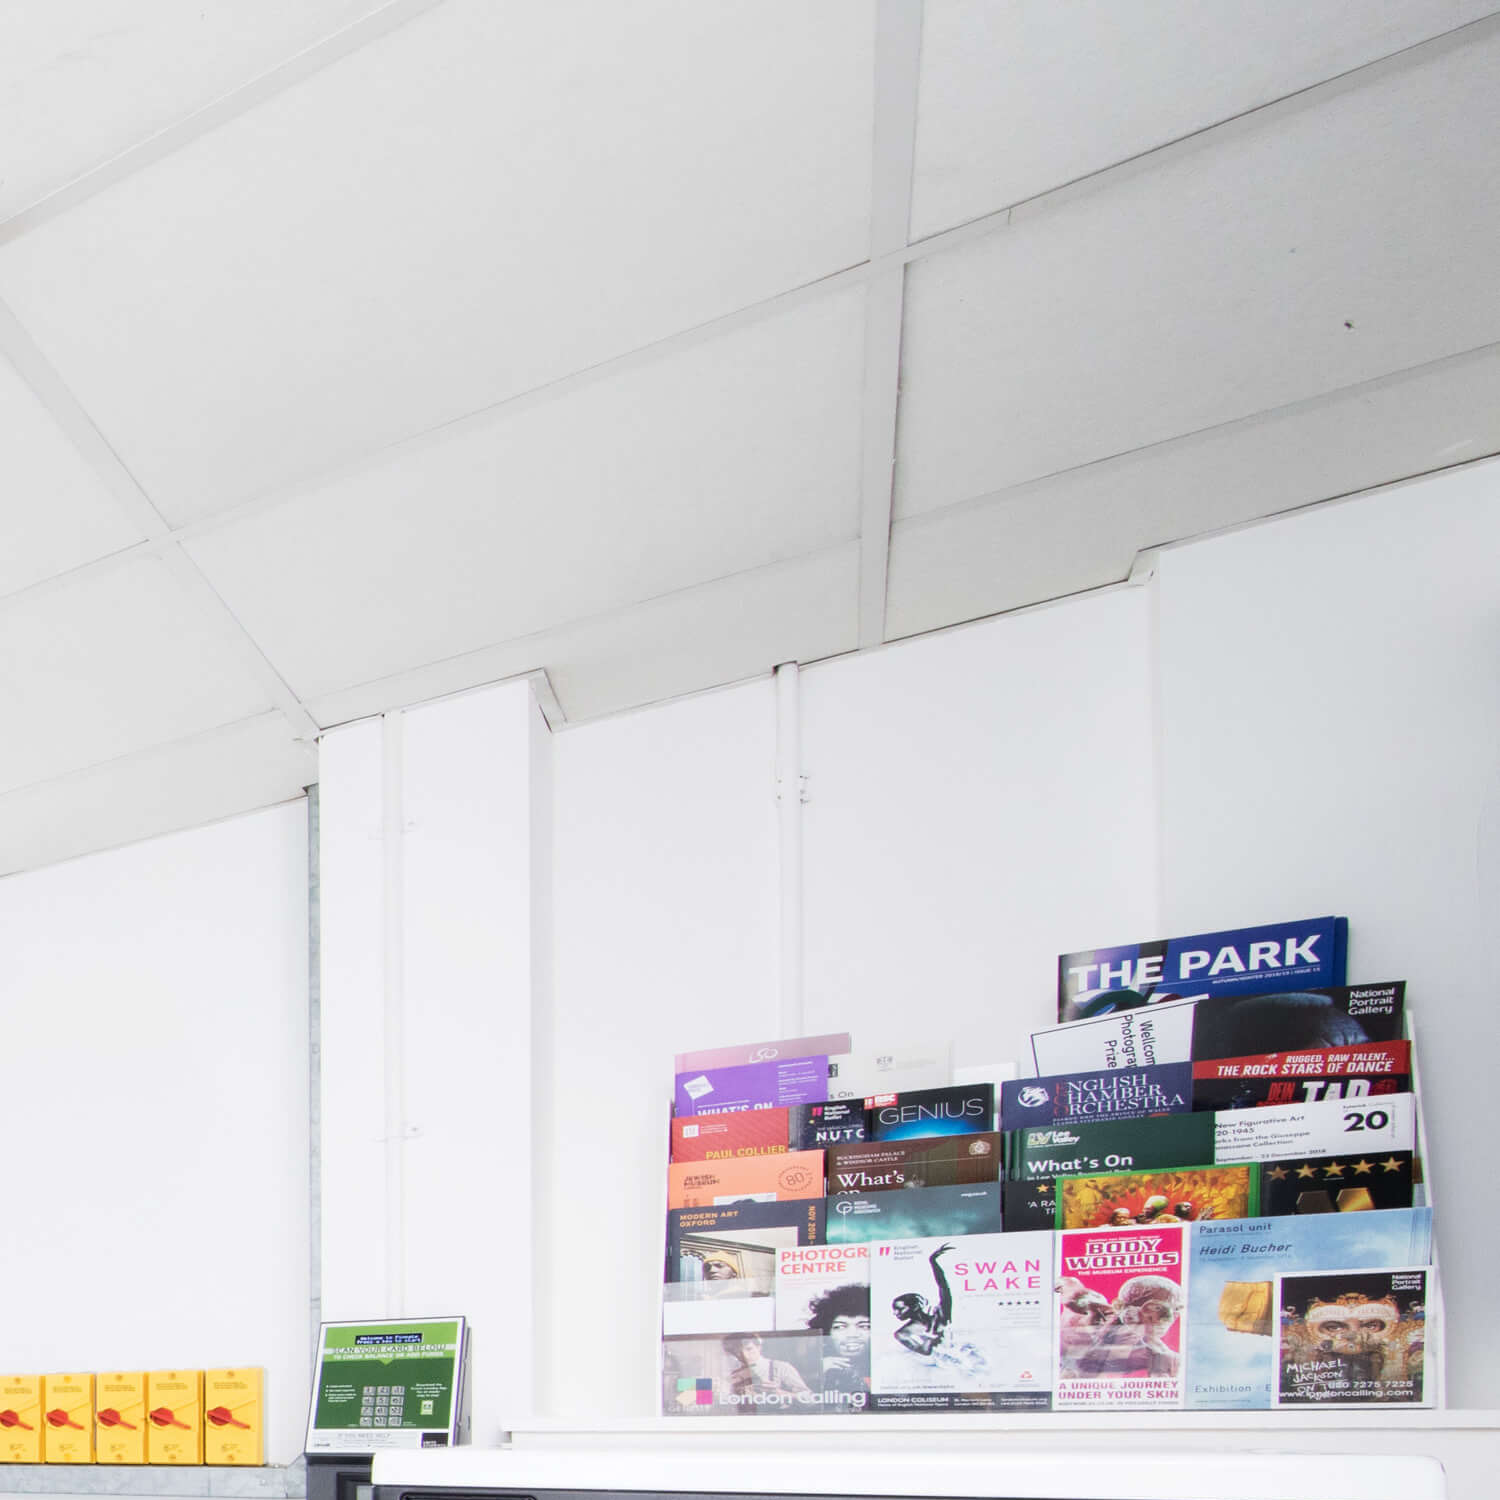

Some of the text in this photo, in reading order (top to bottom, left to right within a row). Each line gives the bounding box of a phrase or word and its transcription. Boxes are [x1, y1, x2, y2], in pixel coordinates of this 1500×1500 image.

[1069, 935, 1321, 992] THE PARK
[1350, 987, 1395, 999] National
[1349, 997, 1394, 1007] Portrait
[1348, 1006, 1392, 1016] Gallery
[1104, 1040, 1117, 1068] Prize
[1286, 1054, 1324, 1064] RUGGED,
[1328, 1053, 1350, 1062] RAW
[1218, 1061, 1392, 1076] THE ROCK STARS OF DANCE
[879, 1099, 984, 1125] GENIUS
[1343, 1110, 1389, 1132] 20
[1052, 1135, 1080, 1144] Valley
[706, 1144, 785, 1160] PAUL COLLIER
[1027, 1154, 1133, 1173] What's On
[785, 1172, 805, 1187] 80
[836, 1170, 904, 1187] What's
[680, 1212, 718, 1221] MODERN
[1200, 1223, 1272, 1234] Parasol unit
[1086, 1239, 1162, 1255] BODY
[1200, 1242, 1292, 1256] Heidi Bucher
[954, 1259, 1040, 1276] SWAN
[1065, 1252, 1180, 1269] WORLDS
[781, 1262, 846, 1275] CENTRE
[964, 1276, 1041, 1291] LAKE
[1286, 1359, 1347, 1373] MICHAEL
[1072, 1382, 1116, 1390] UNIQUE
[1120, 1381, 1178, 1390] JOURNEY
[1195, 1384, 1252, 1393] Exhibition
[718, 1389, 866, 1408] London Calling
[1059, 1390, 1179, 1399] UNDER YOUR SKIN
